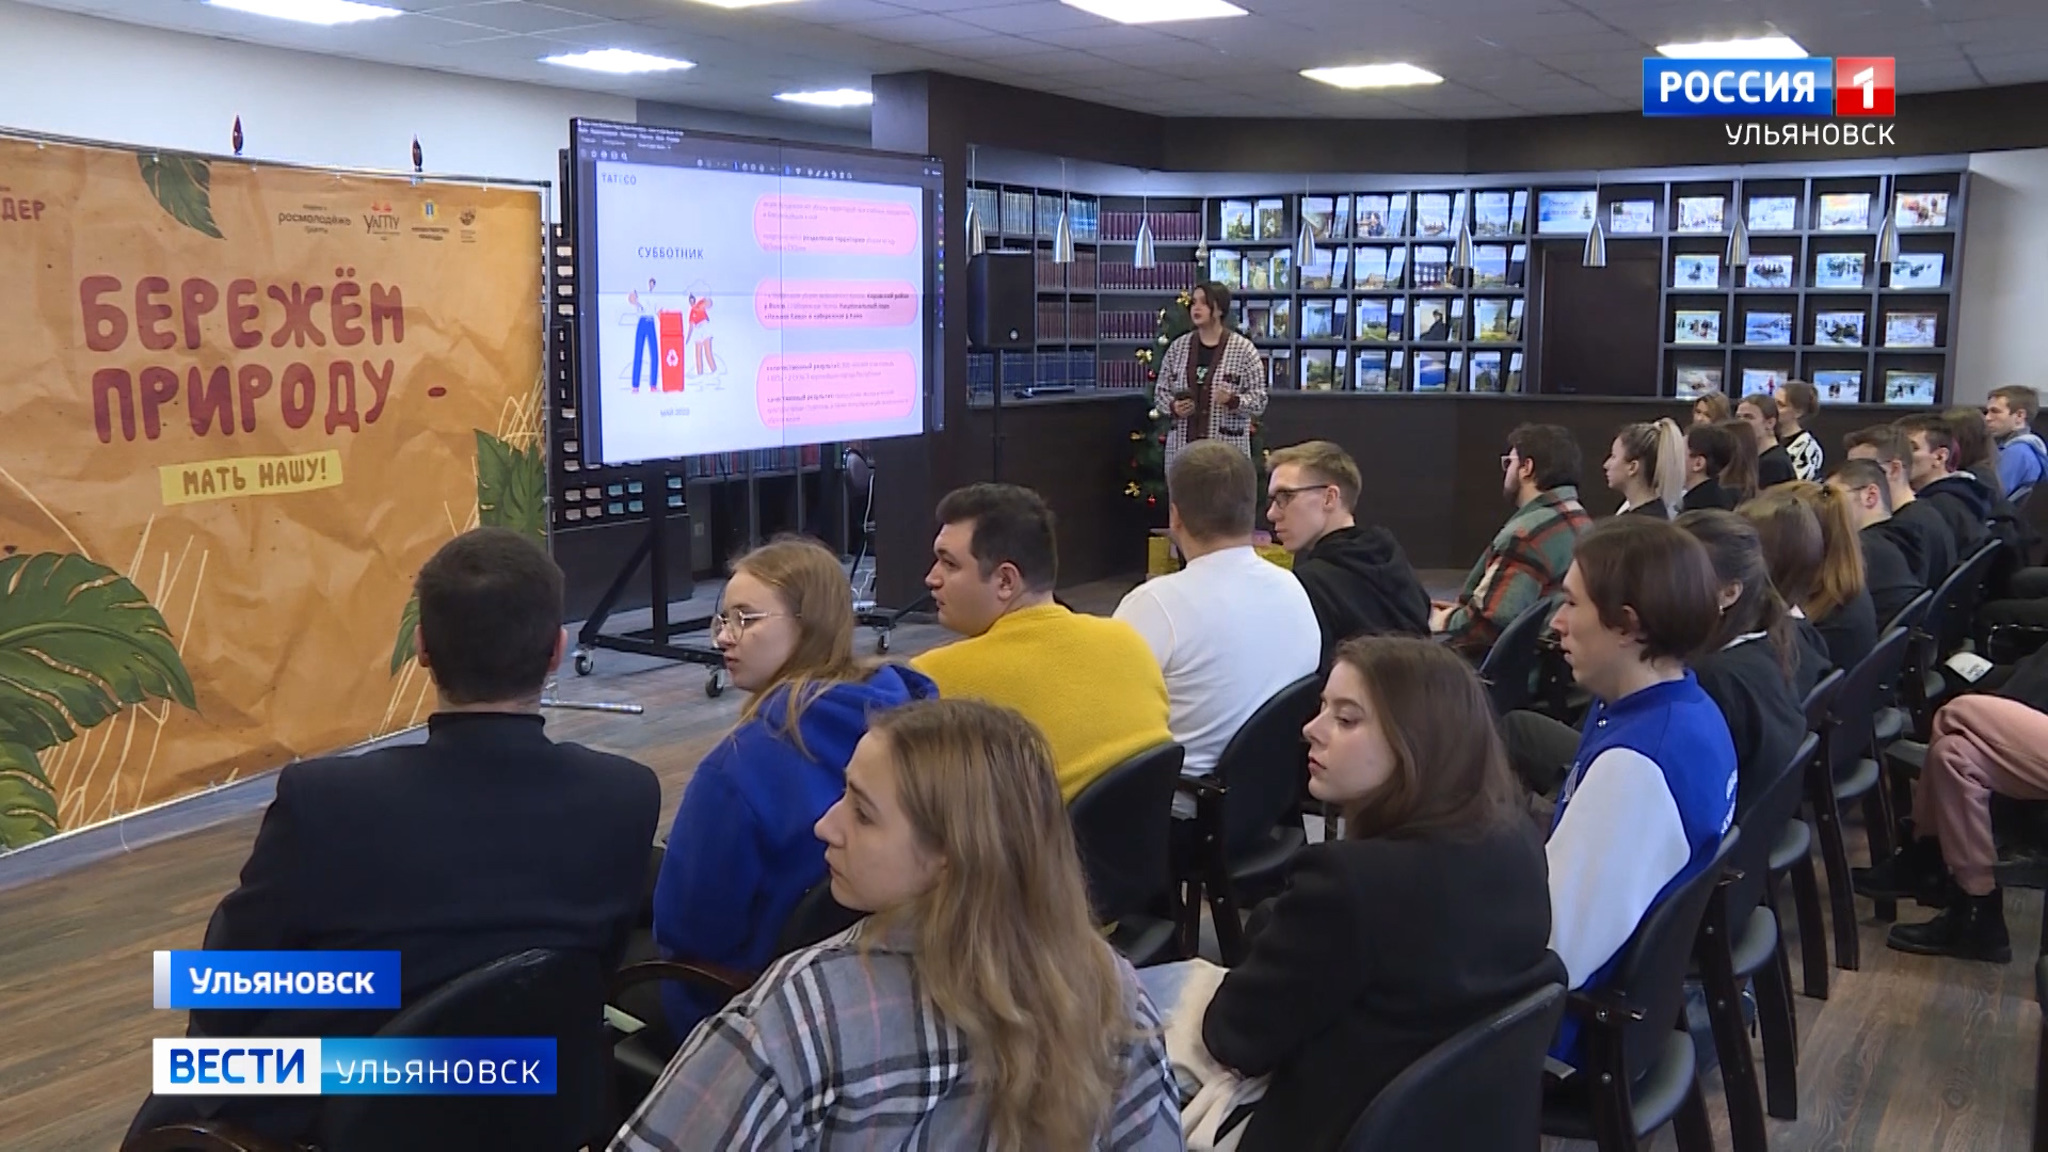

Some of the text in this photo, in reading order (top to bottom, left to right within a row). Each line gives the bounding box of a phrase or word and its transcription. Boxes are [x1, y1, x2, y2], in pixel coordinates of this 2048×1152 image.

[637, 246, 704, 259] СУББОТНИК
[79, 267, 405, 352] БЕРЕЖЁМ
[92, 359, 394, 444] ПРИРОДУ
[182, 456, 327, 496] МАТЬ НАШУ!
